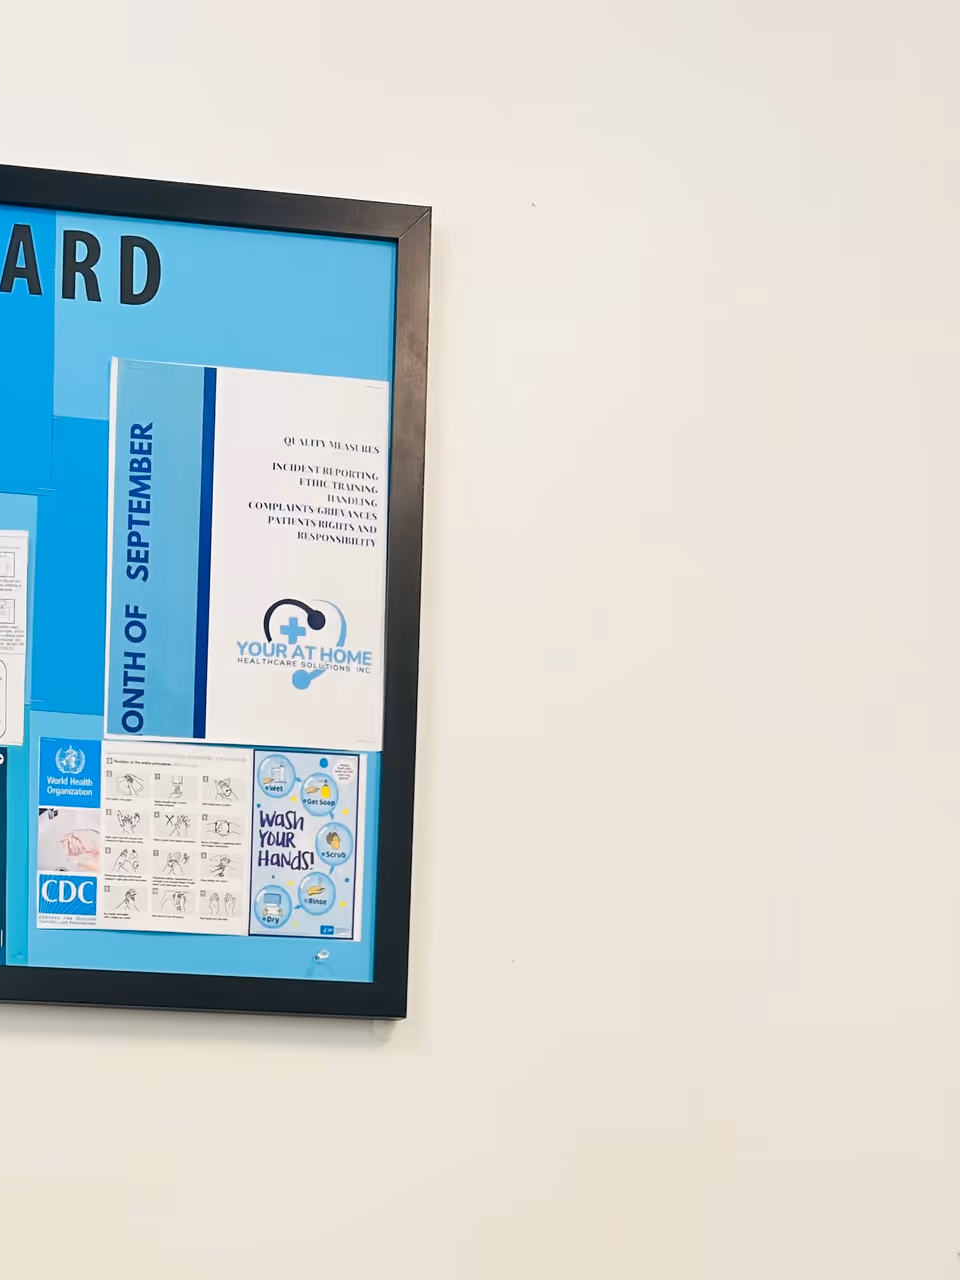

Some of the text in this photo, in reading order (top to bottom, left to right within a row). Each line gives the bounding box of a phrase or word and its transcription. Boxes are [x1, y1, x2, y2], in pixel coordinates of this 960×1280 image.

[284, 437, 379, 453] QUALITY MEASURES
[272, 462, 378, 479] INCIDENT REPORTING
[328, 494, 376, 506] HANDLING
[268, 516, 377, 534] PATIENTS RIGHTS AND
[298, 531, 374, 546] RESPONSIBILITY
[121, 422, 153, 736] ONTH OF SEPTEMBER
[237, 641, 372, 666] YOUR AT HOME
[237, 658, 298, 667] HEALTHCARE
[300, 662, 350, 672] SOLUTIONS
[46, 776, 94, 786] World Health
[46, 785, 92, 796] Organization
[41, 880, 94, 904] CDC
[266, 916, 279, 924] Dry
